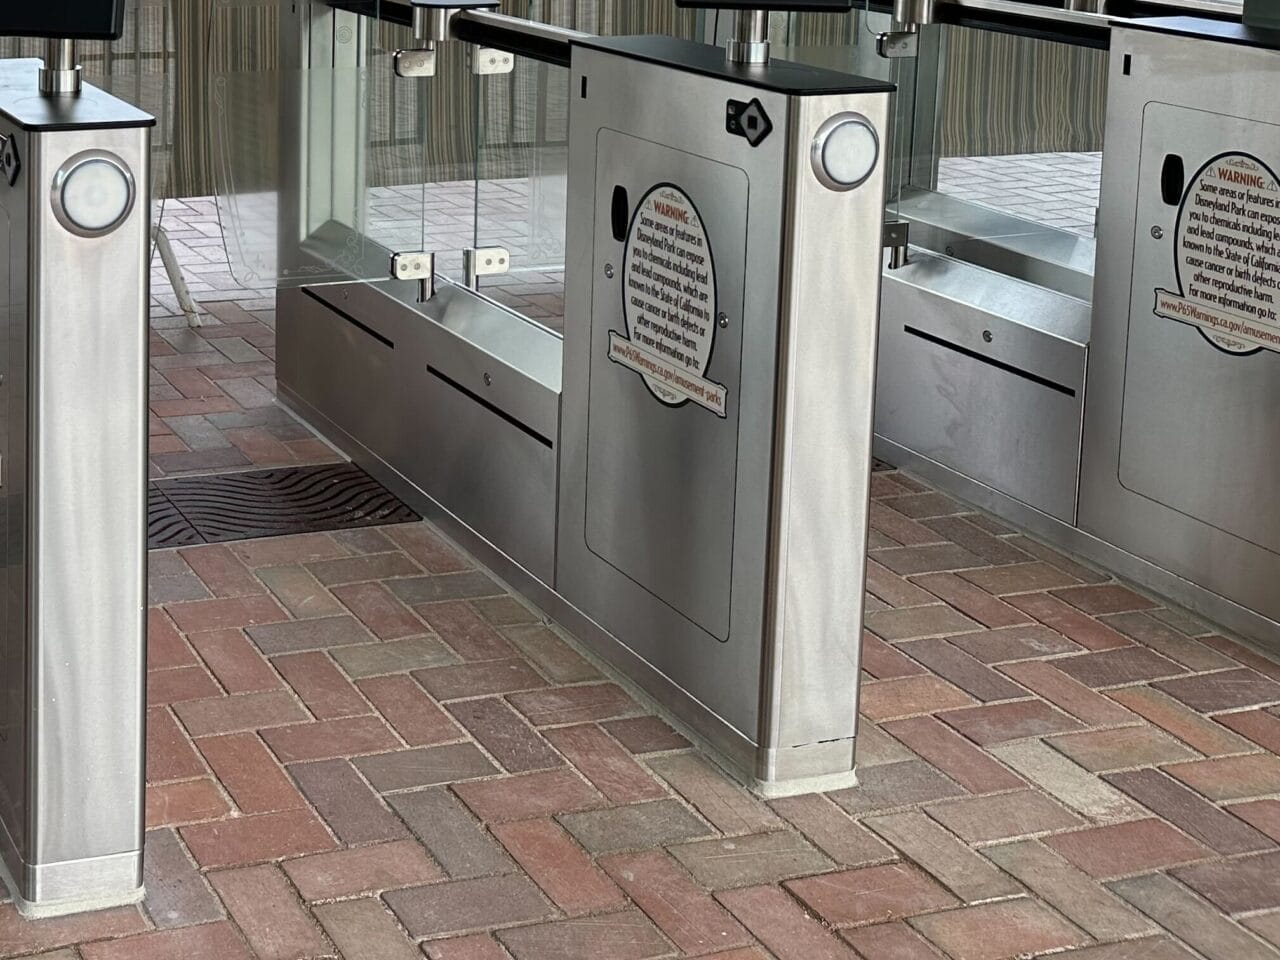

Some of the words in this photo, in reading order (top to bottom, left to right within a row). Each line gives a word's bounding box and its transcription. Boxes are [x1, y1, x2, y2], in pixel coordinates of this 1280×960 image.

[1200, 179, 1218, 194] Some
[1219, 186, 1237, 199] areas
[1238, 191, 1245, 200] or
[1246, 189, 1274, 208] features
[1218, 167, 1265, 189] WARNING:
[653, 200, 689, 225] WARNING:
[1195, 193, 1230, 212] Disneyland
[1231, 201, 1246, 217] Park
[1247, 209, 1259, 220] can
[640, 212, 654, 229] Some
[654, 221, 669, 234] areas
[669, 227, 674, 236] or
[675, 224, 696, 246] features
[697, 234, 702, 247] in
[1187, 224, 1199, 236] and
[1200, 224, 1215, 240] lead
[1256, 240, 1276, 256] which
[1189, 211, 1200, 221] you
[1202, 212, 1208, 223] to
[1210, 212, 1241, 231] chemicals
[1241, 221, 1272, 242] including
[637, 227, 663, 250] Disneyland
[664, 238, 675, 254] Park
[676, 247, 685, 258] can
[686, 251, 704, 266] expose
[1183, 236, 1205, 253] known
[1205, 243, 1212, 255] to
[1213, 244, 1224, 258] the
[1225, 248, 1242, 264] State
[1242, 253, 1250, 268] of
[631, 261, 641, 274] and
[641, 261, 652, 279] lead
[683, 281, 698, 298] which
[699, 291, 708, 303] are
[633, 246, 641, 258] you
[642, 247, 648, 260] to
[648, 248, 672, 270] chemicals
[673, 260, 695, 282] including
[696, 267, 708, 285] lead
[1186, 256, 1204, 268] cause
[1205, 260, 1225, 274] cancer
[1226, 267, 1234, 276] or
[1235, 264, 1251, 281] birth
[1252, 270, 1276, 288] defects
[629, 272, 645, 292] known
[645, 282, 650, 295] to
[651, 283, 659, 299] the
[660, 288, 673, 305] State
[673, 294, 679, 309] of
[679, 296, 704, 319] California
[704, 307, 710, 322] to
[1189, 283, 1199, 297] For
[1200, 290, 1217, 303] more
[1218, 293, 1256, 315] information
[1257, 308, 1267, 319] go
[1267, 309, 1277, 321] to:
[1193, 270, 1211, 285] other
[1211, 279, 1253, 298] reproductive
[1254, 286, 1274, 304] harm.
[631, 296, 644, 309] cause
[645, 301, 660, 316] cancer
[661, 309, 667, 319] or
[667, 307, 680, 325] birth
[680, 314, 699, 334] defects
[699, 327, 706, 337] or
[637, 312, 650, 328] other
[651, 322, 681, 344] reproductive
[1160, 299, 1280, 344] www.P65Warnings.ca.gov/amusemen
[633, 326, 641, 340] For
[642, 334, 655, 348] more
[655, 338, 684, 361] information
[685, 353, 692, 367] go
